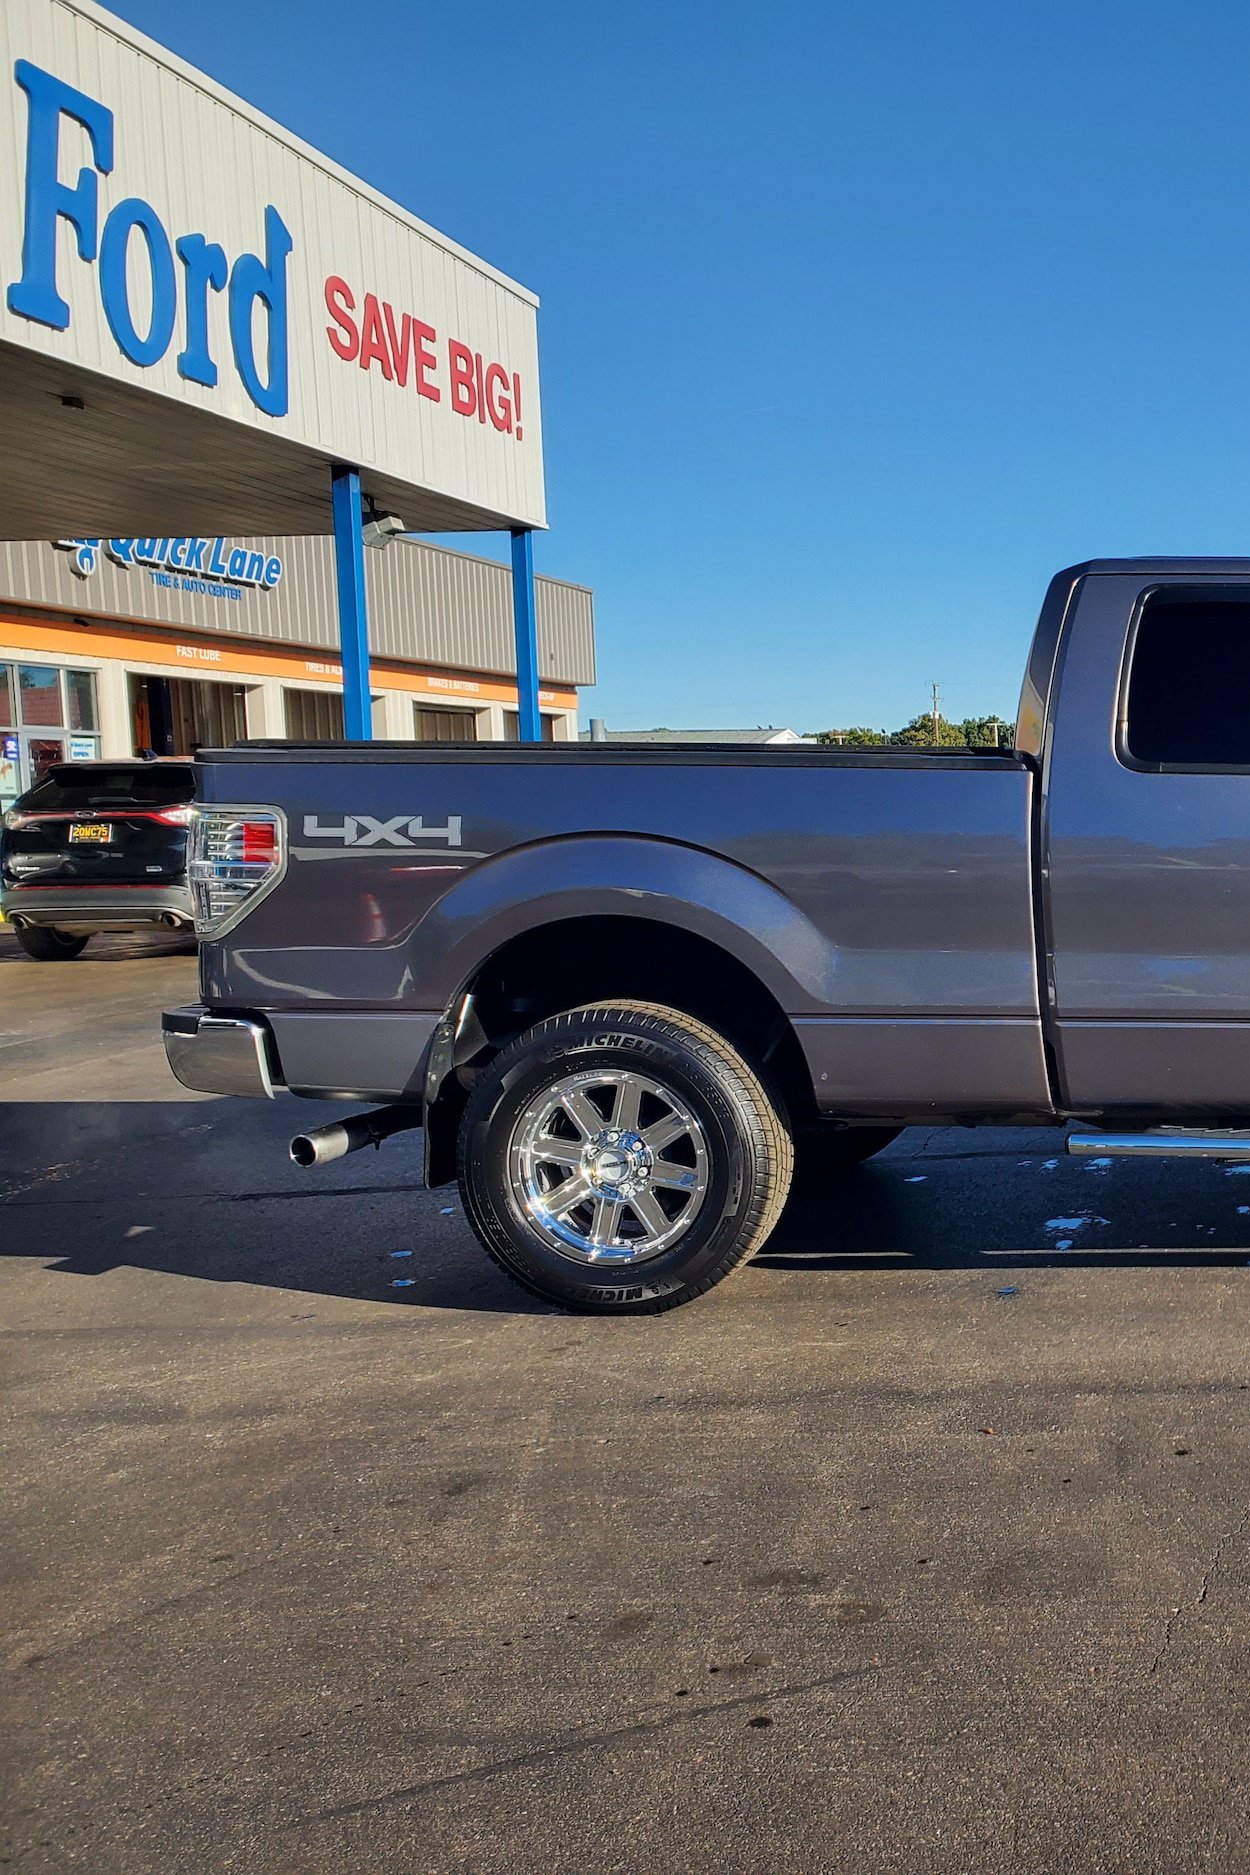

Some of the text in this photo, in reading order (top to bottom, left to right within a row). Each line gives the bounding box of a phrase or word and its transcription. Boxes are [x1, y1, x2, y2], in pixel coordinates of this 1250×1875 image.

[7, 59, 293, 417] Ford
[325, 275, 523, 441] SAVE BIG!
[208, 536, 283, 588] Lane
[149, 571, 243, 601] TIRE & AUTO CENTER
[176, 645, 222, 662] FAST LUBE
[568, 1034, 679, 1058] MICHELIN
